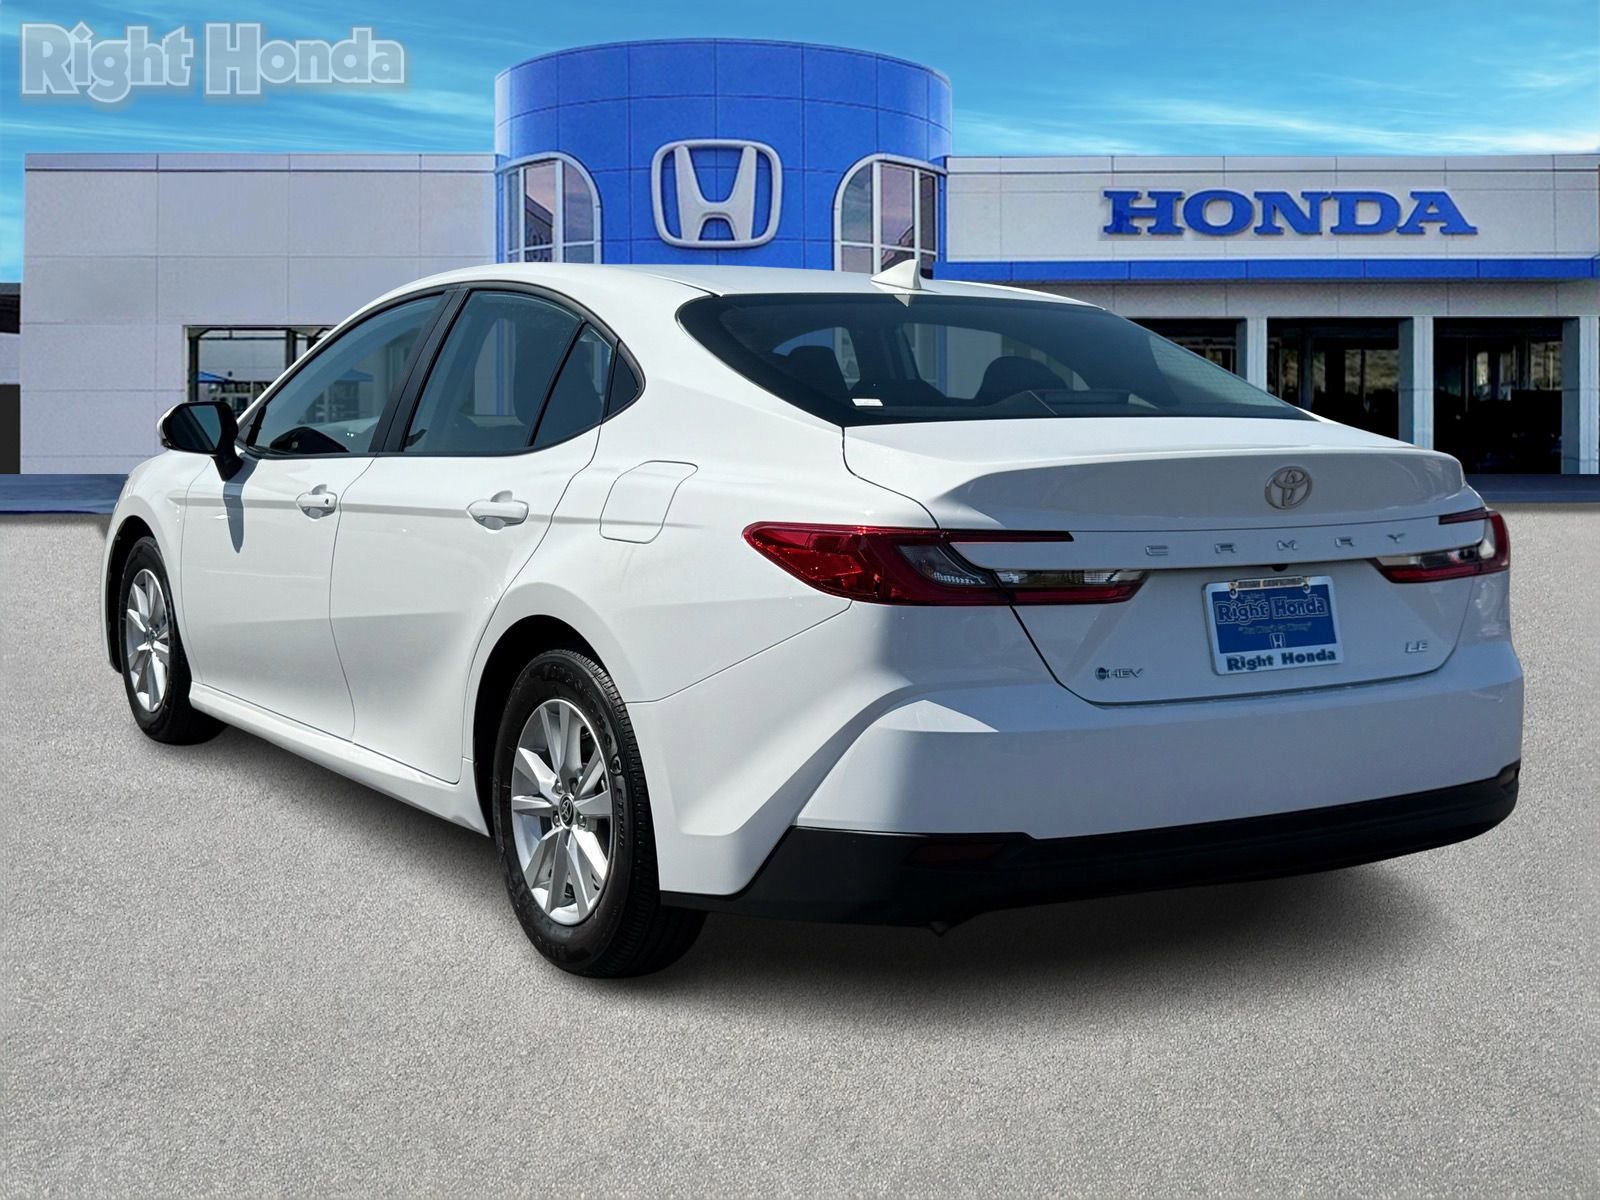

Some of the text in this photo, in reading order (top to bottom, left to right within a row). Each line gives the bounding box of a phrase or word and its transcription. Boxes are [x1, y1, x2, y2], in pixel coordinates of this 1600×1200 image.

[1102, 189, 1478, 236] HONDA
[1145, 533, 1406, 556] CAMRY
[1214, 594, 1328, 625] Right Honda
[1404, 640, 1428, 653] LE
[1226, 649, 1336, 671] Right Honda
[1106, 668, 1144, 679] HEV
